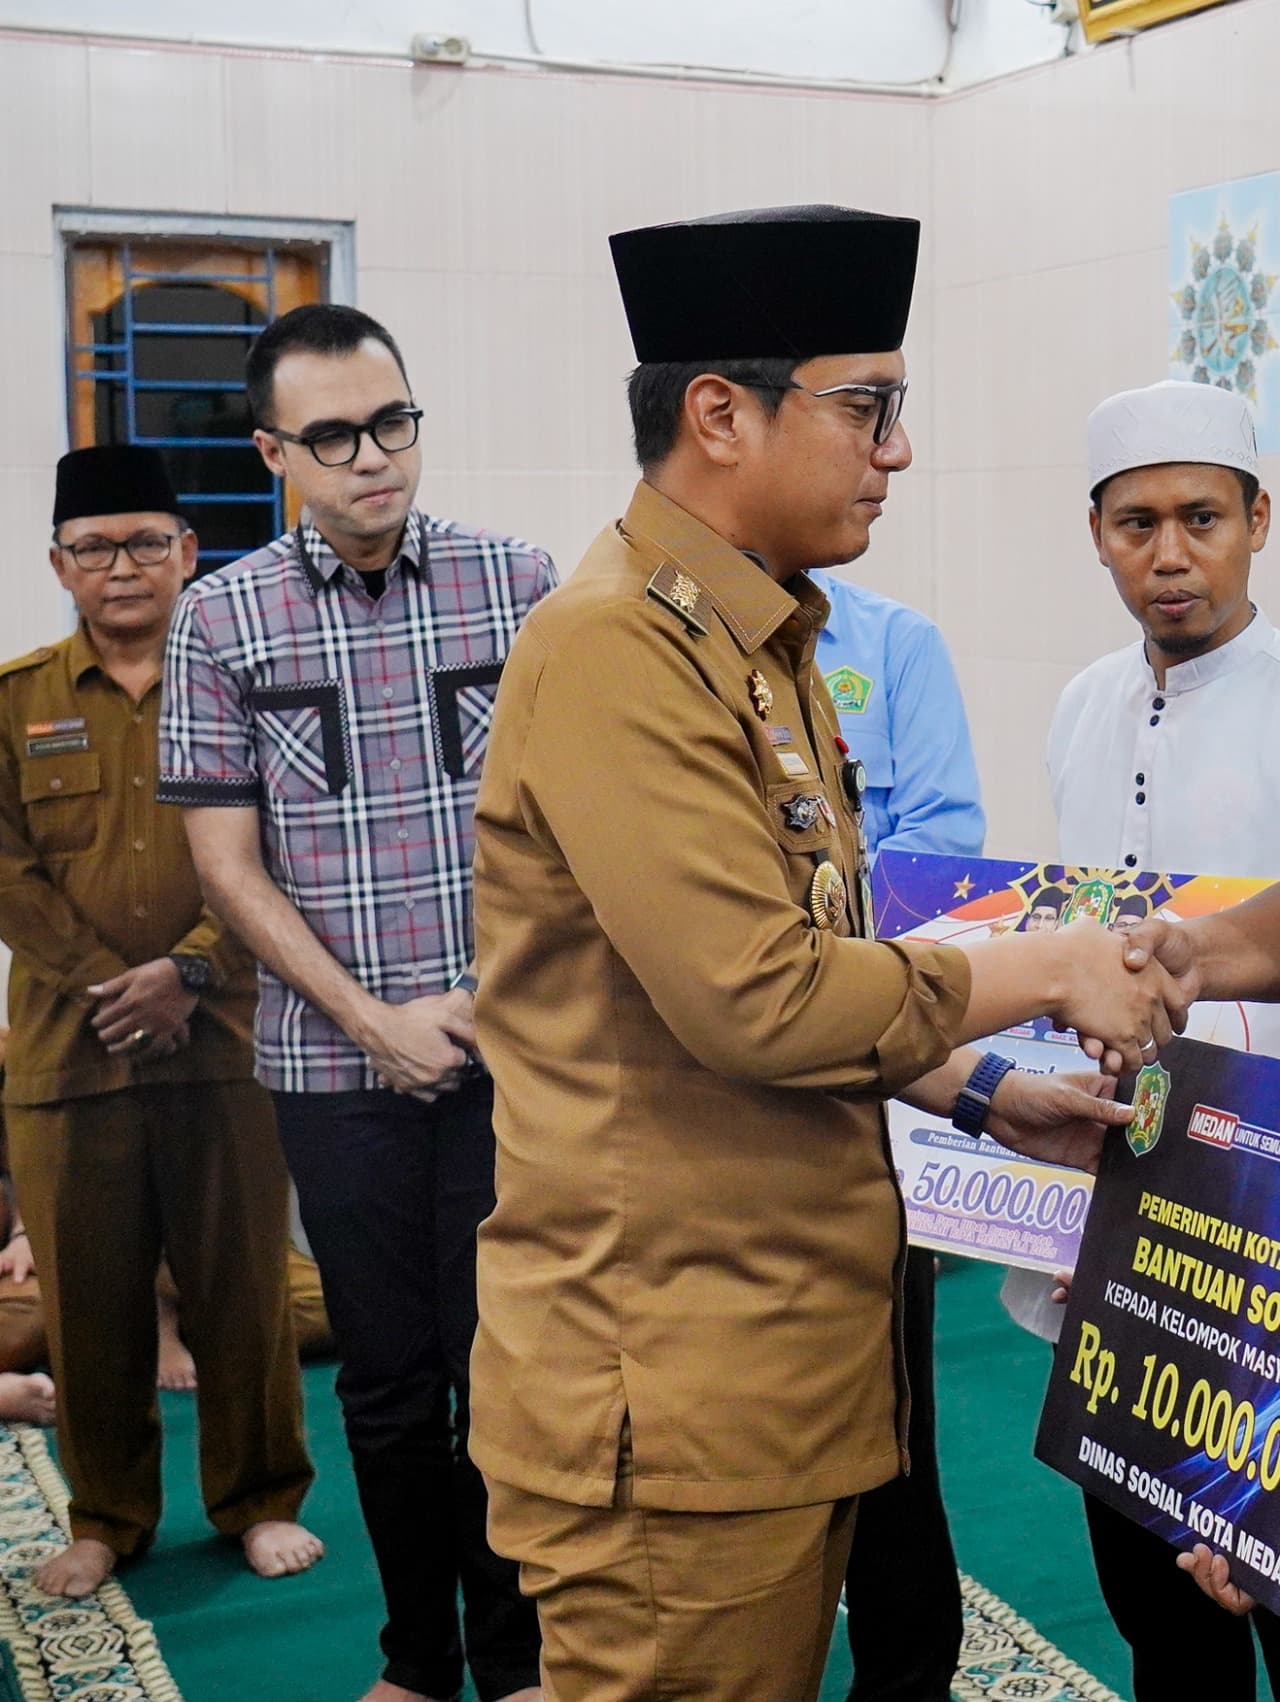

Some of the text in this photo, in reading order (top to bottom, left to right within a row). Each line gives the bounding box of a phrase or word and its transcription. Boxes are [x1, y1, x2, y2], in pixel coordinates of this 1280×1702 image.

[927, 1132, 1017, 1158] Pemberian Bantuan
[1190, 1111, 1236, 1143] MEDAN
[1234, 1127, 1262, 1149] UNTUK
[912, 1161, 1088, 1233] 50.000.00
[1138, 1191, 1243, 1254] PEMERINTAH
[1132, 1236, 1245, 1315] BANTUAN
[1104, 1279, 1157, 1325] KEPADA
[1160, 1305, 1242, 1363] KELOMPOK
[1069, 1320, 1120, 1415] Rp.
[1078, 1435, 1126, 1485] DINAS
[1127, 1465, 1185, 1522] SOSIAL
[1187, 1501, 1234, 1552] KOTA
